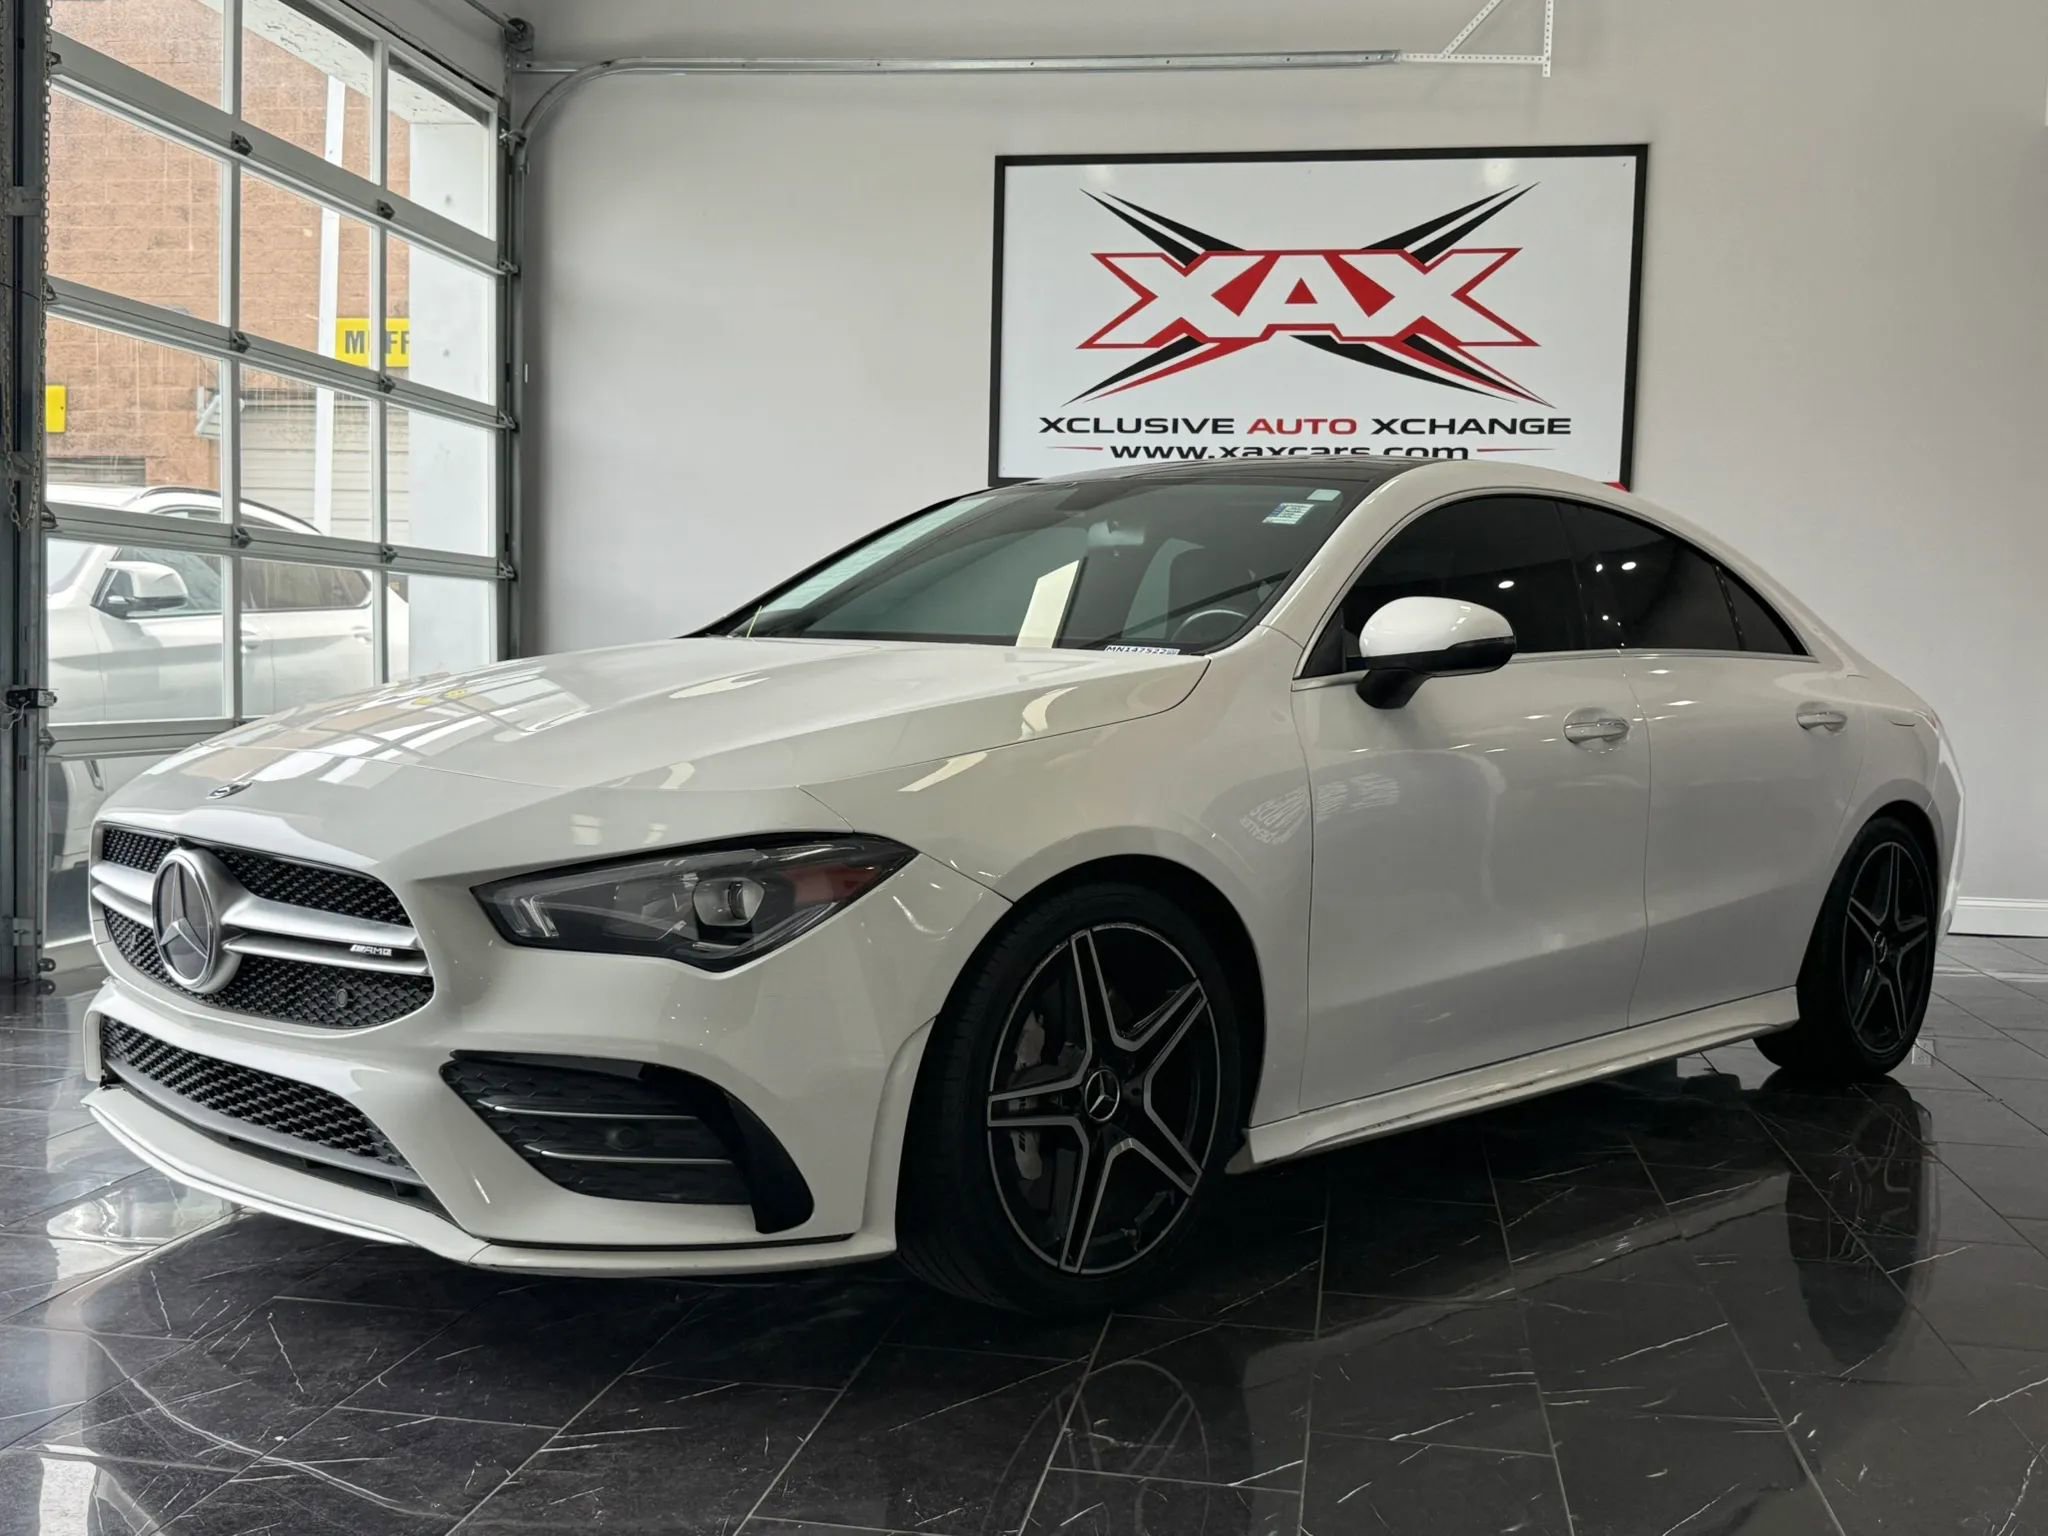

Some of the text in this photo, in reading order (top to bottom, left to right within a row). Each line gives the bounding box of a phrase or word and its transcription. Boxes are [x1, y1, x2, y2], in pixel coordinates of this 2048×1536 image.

[1077, 247, 1541, 349] XAX
[345, 330, 409, 354] MFF
[1038, 417, 1572, 435] XCLUSIVE AUTO XCHANGE
